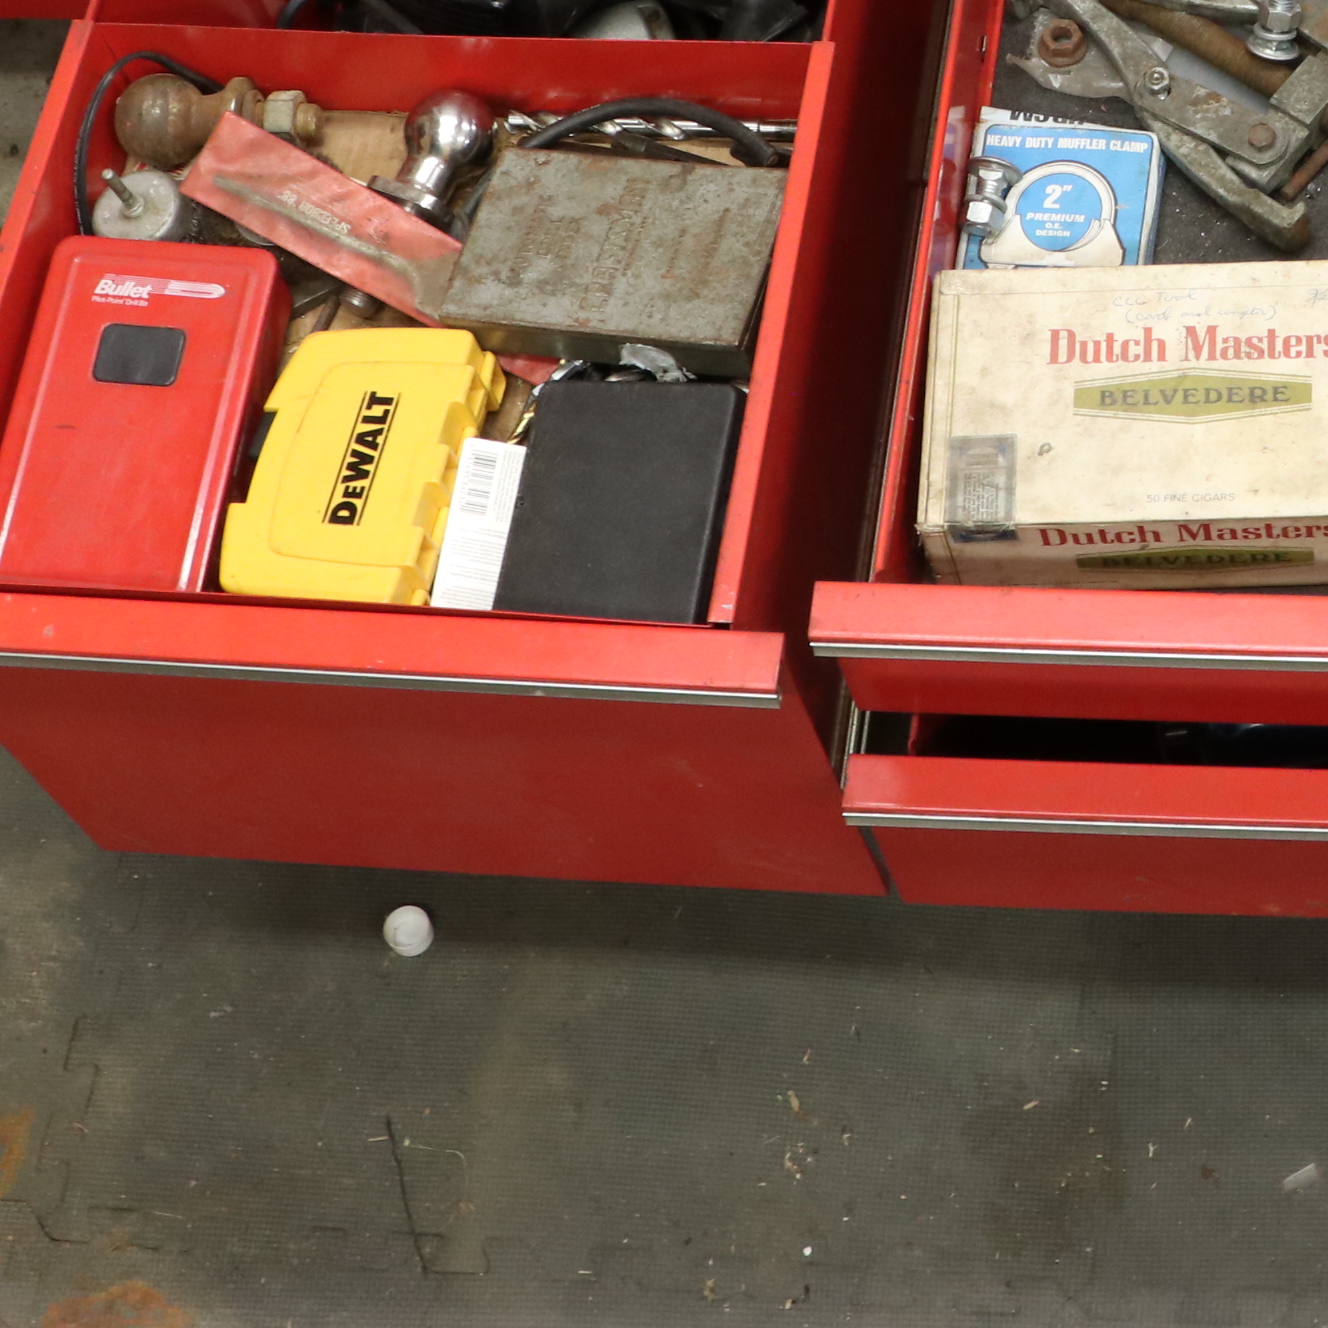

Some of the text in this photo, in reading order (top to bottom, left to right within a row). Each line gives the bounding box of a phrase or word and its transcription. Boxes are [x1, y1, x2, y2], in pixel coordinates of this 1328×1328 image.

[986, 134, 1149, 154] HEAVY DUTY MUFFLER CLAMP
[1026, 212, 1086, 222] PREMIUM
[1035, 229, 1071, 237] DESIGN
[94, 279, 152, 298] Bullet
[1046, 326, 1168, 366] Dutch
[1100, 385, 1292, 407] BELVEDERE
[1146, 492, 1236, 504] 50 FINE CIGARS
[1037, 524, 1164, 547] Dutch
[1101, 550, 1293, 568] BELVEDERE
